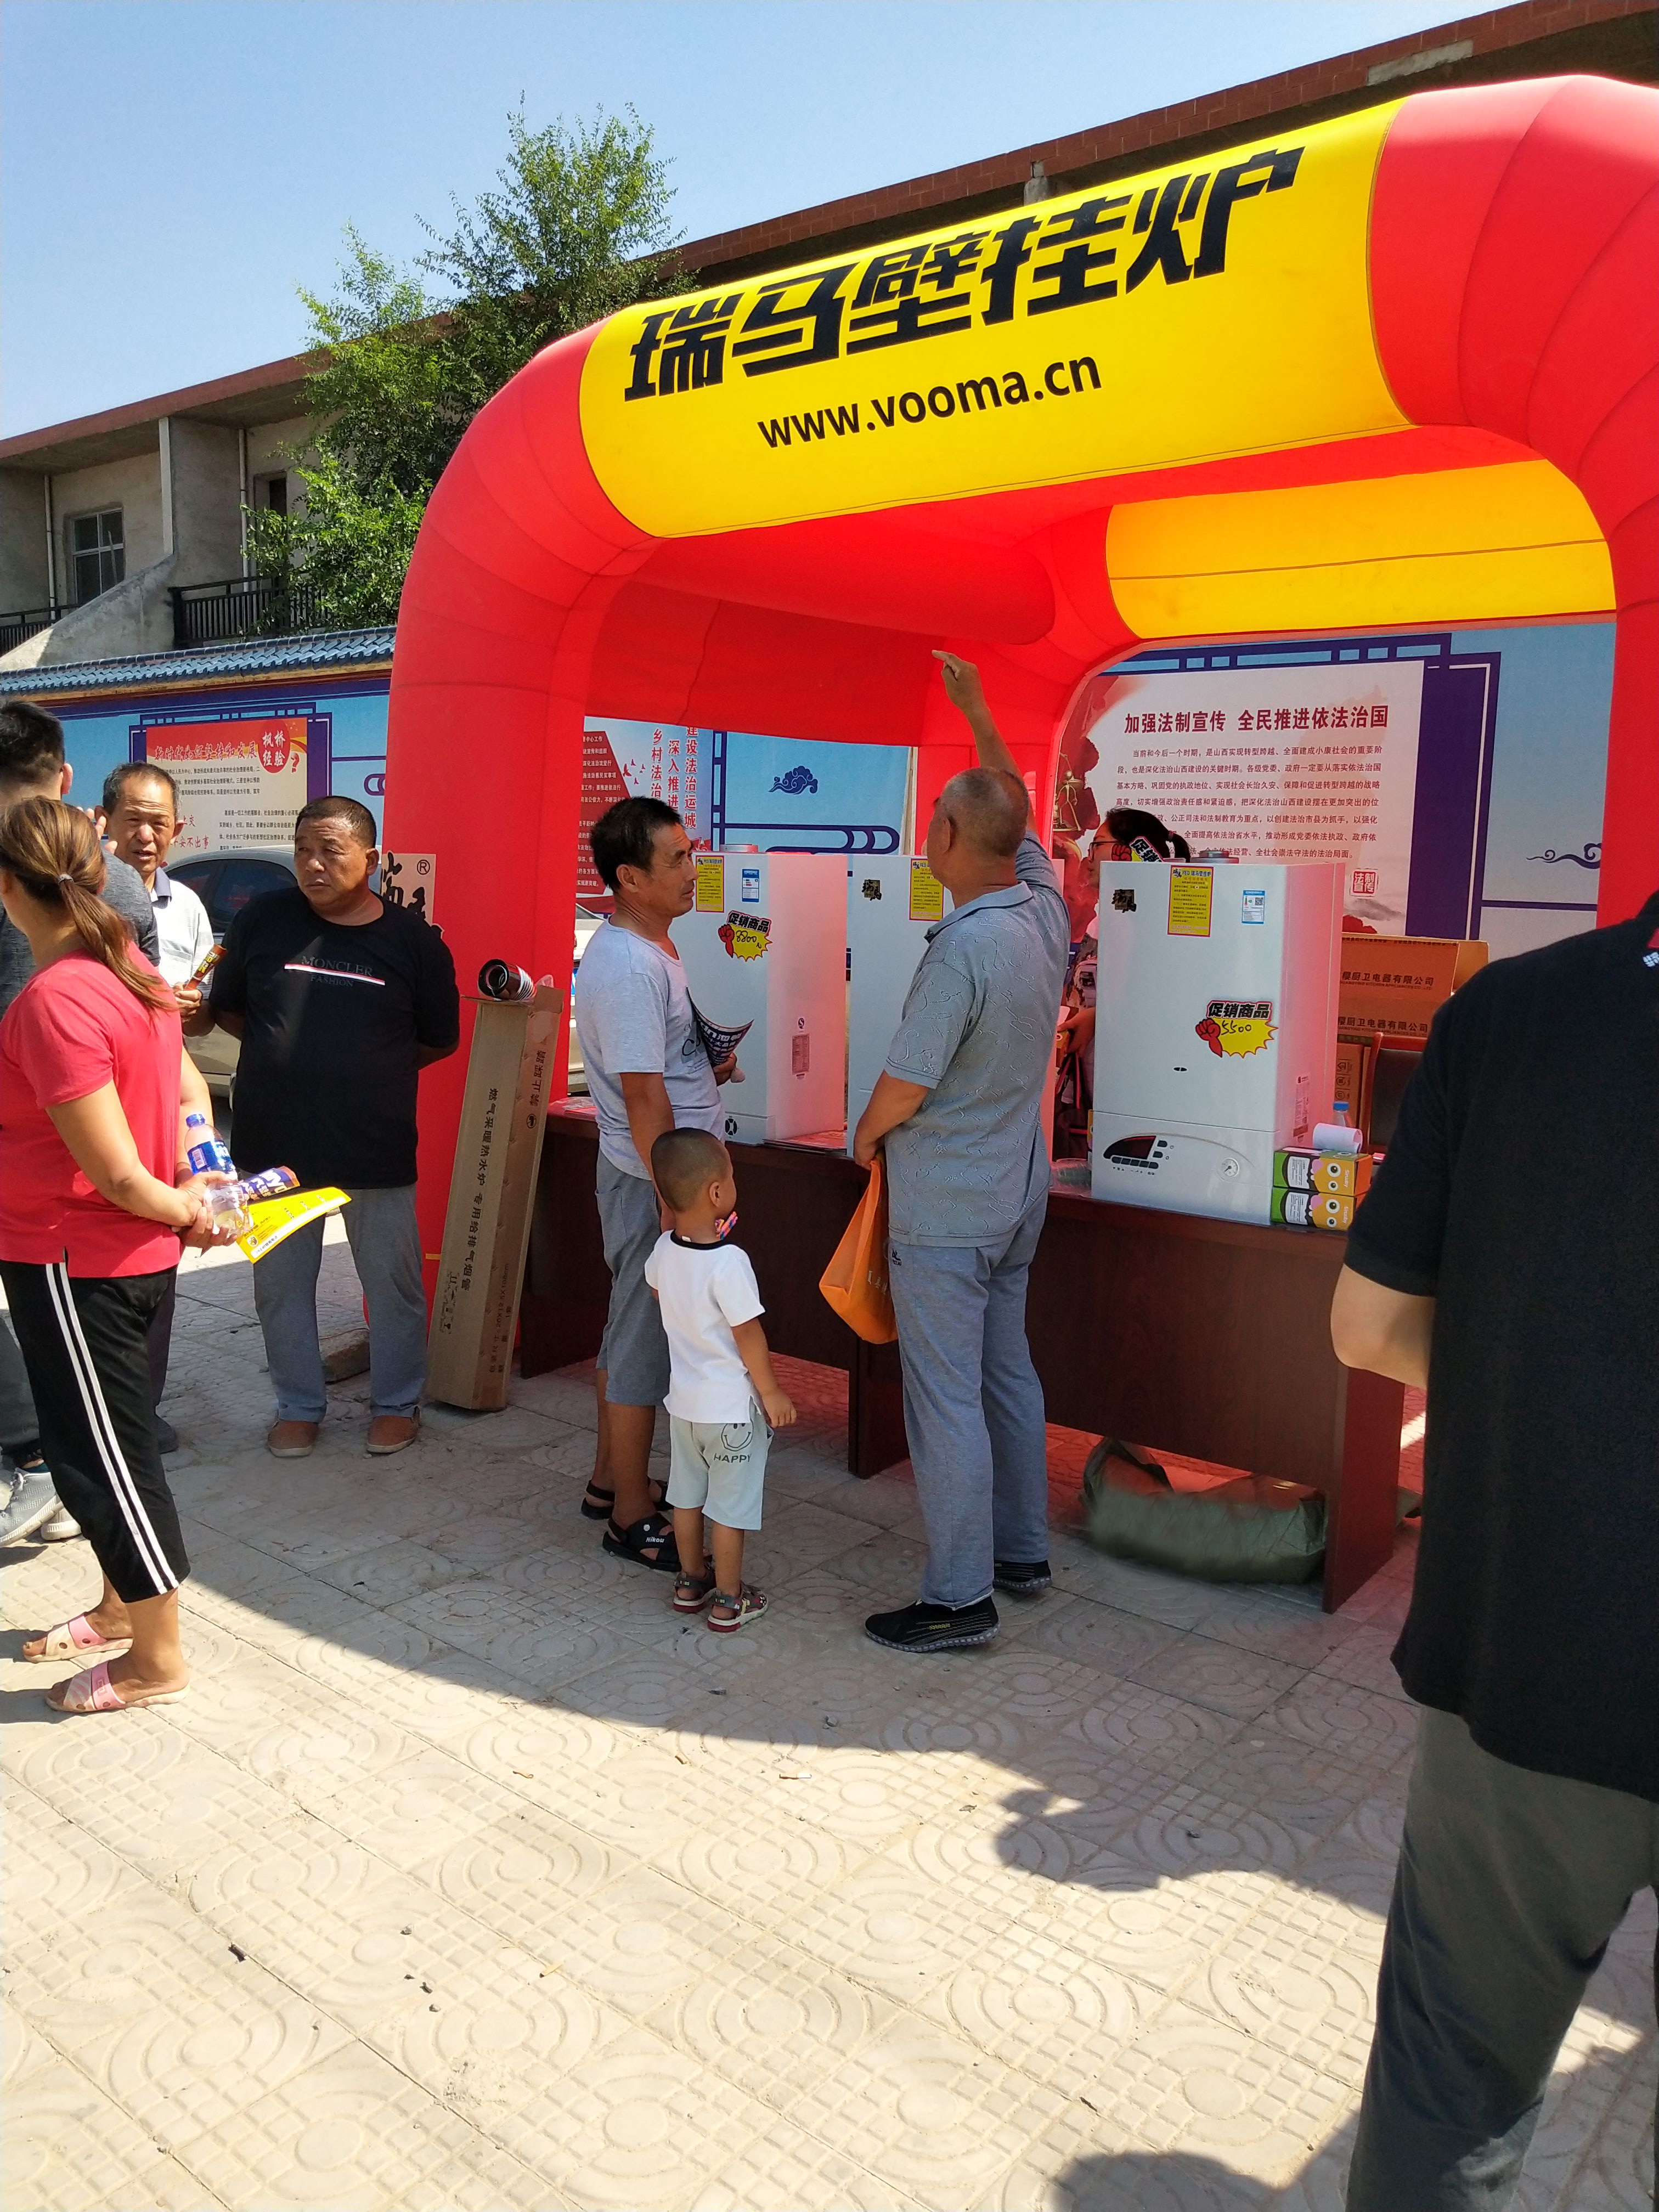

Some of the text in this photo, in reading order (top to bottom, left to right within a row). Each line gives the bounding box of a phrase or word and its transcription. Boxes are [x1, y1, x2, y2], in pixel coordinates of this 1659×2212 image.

[625, 146, 1306, 401] 瑞马壁挂炉
[759, 356, 1101, 448] www.vooma.cn
[1124, 704, 1389, 733] 加强法制宣传 全民推进依法治国
[262, 730, 286, 749] 枫桥
[262, 749, 286, 767] 经验
[728, 912, 770, 933] 促销商品
[736, 930, 757, 943] 8800
[301, 956, 373, 977] MONCLER
[311, 974, 354, 987] FASHION
[1208, 1002, 1270, 1018] 促销商品
[1221, 1020, 1252, 1035] 5500
[461, 1088, 498, 1291] 燃气采暖热水炉 专用给排气烟管
